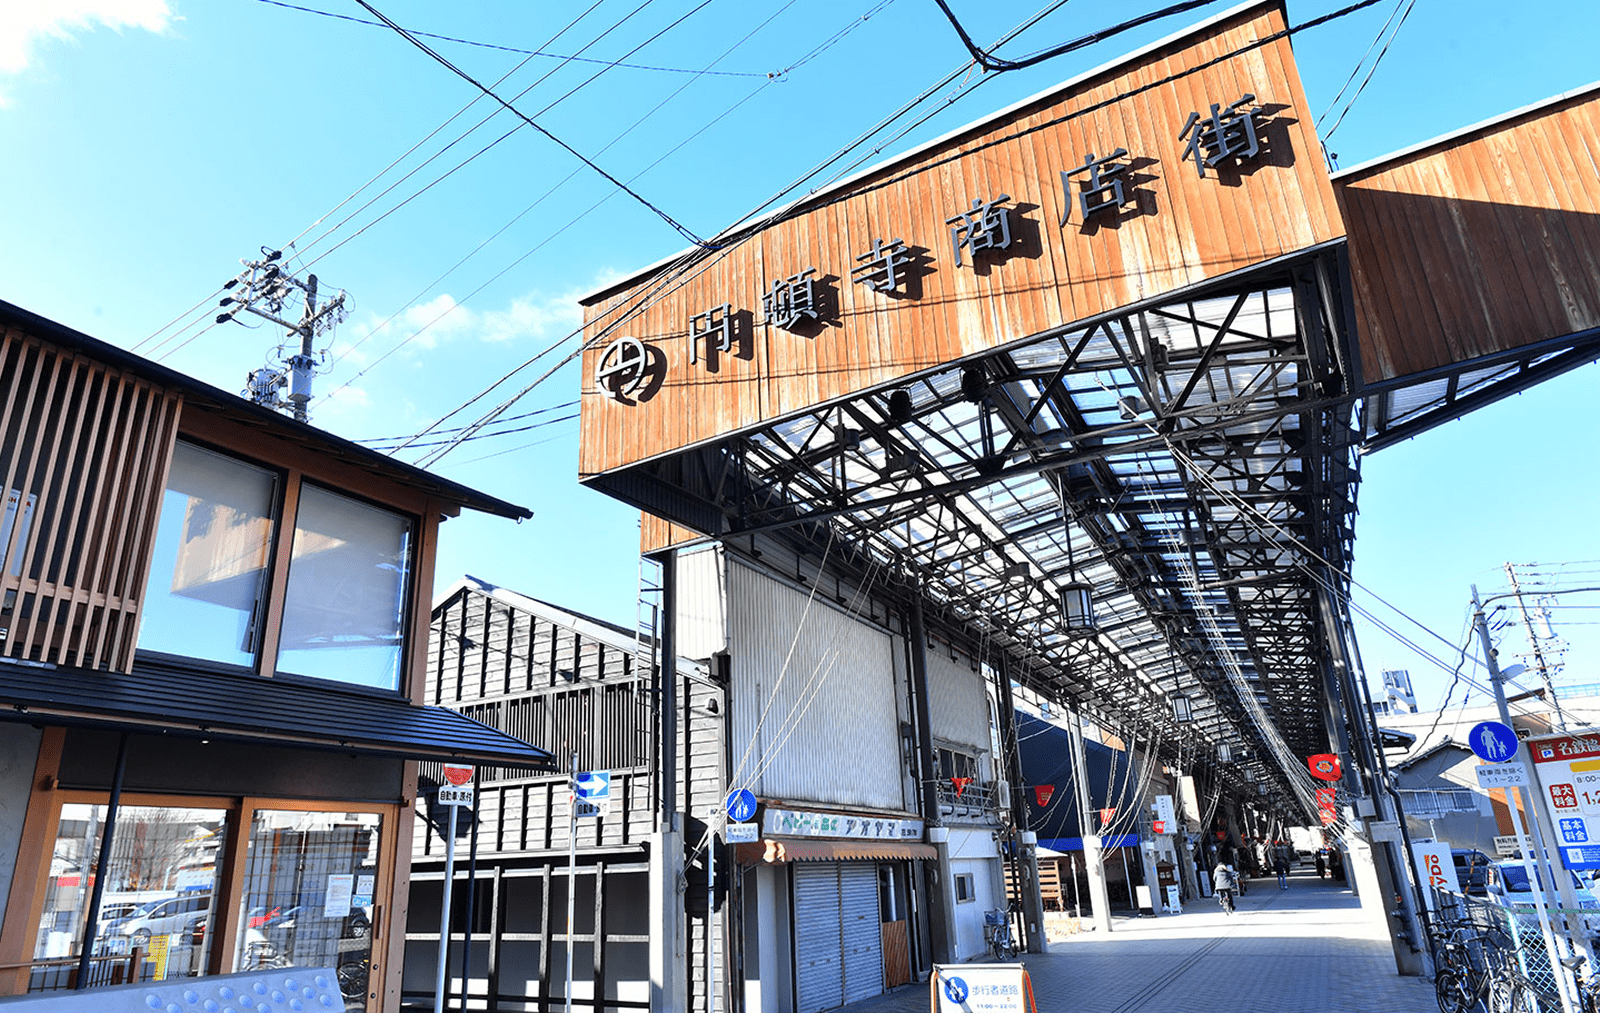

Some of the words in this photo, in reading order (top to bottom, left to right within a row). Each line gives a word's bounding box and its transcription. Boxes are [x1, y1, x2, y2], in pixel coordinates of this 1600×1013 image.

[688, 92, 1260, 367] 円頓寺商店街
[1552, 785, 1573, 796] 最大
[1555, 795, 1576, 806] 料金
[1561, 819, 1582, 830] 基本
[1564, 830, 1586, 841] 料金
[1430, 854, 1448, 890] yDo
